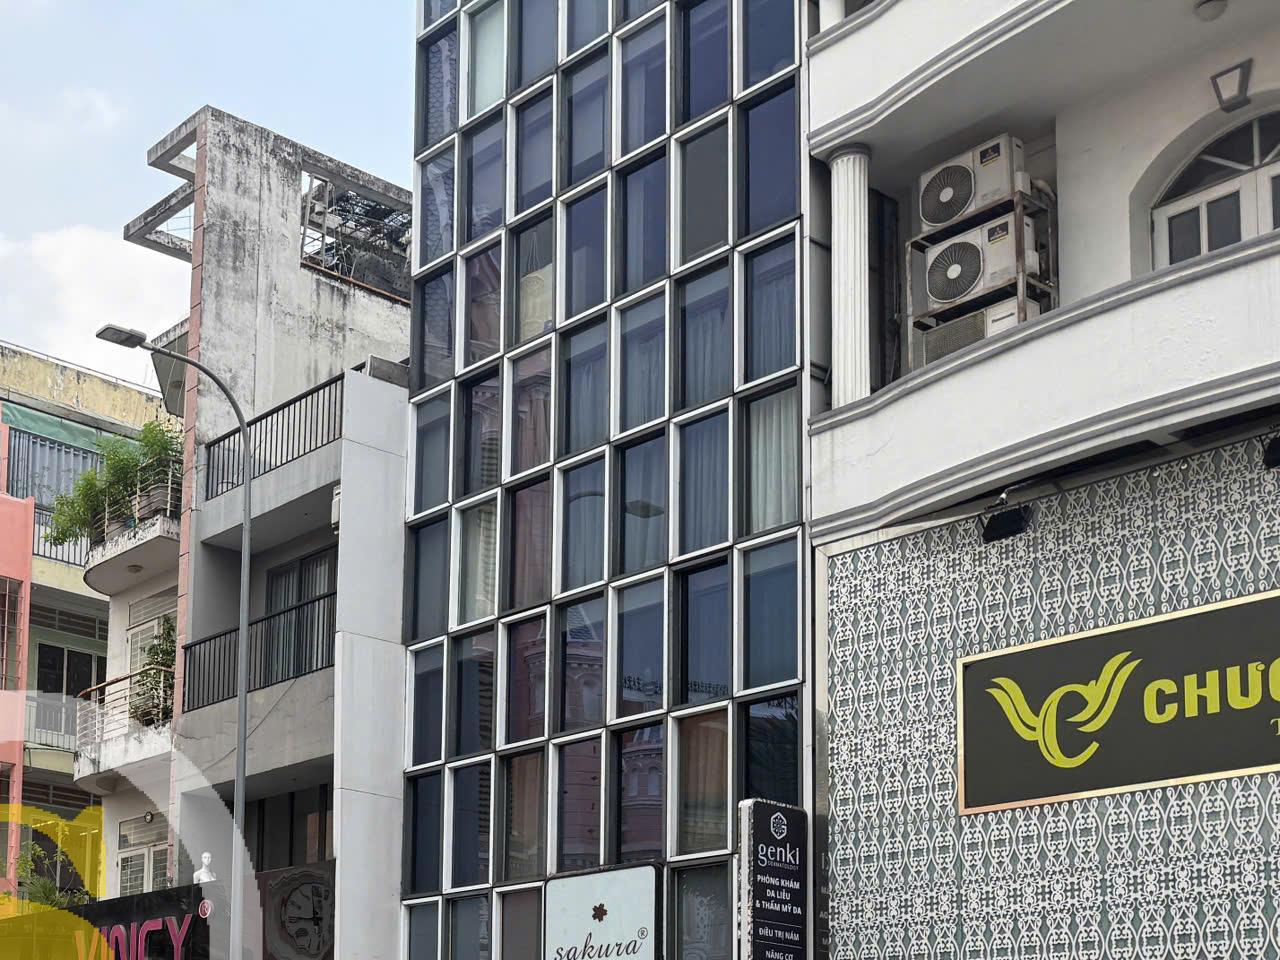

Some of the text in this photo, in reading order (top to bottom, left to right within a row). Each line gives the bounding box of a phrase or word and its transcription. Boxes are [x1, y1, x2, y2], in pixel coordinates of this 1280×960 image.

[758, 843, 800, 867] genki
[757, 874, 800, 890] PHÒNG KHÁM
[766, 889, 776, 898] DA
[756, 900, 760, 908] &
[792, 906, 802, 915] DA
[785, 930, 800, 941] NÁM
